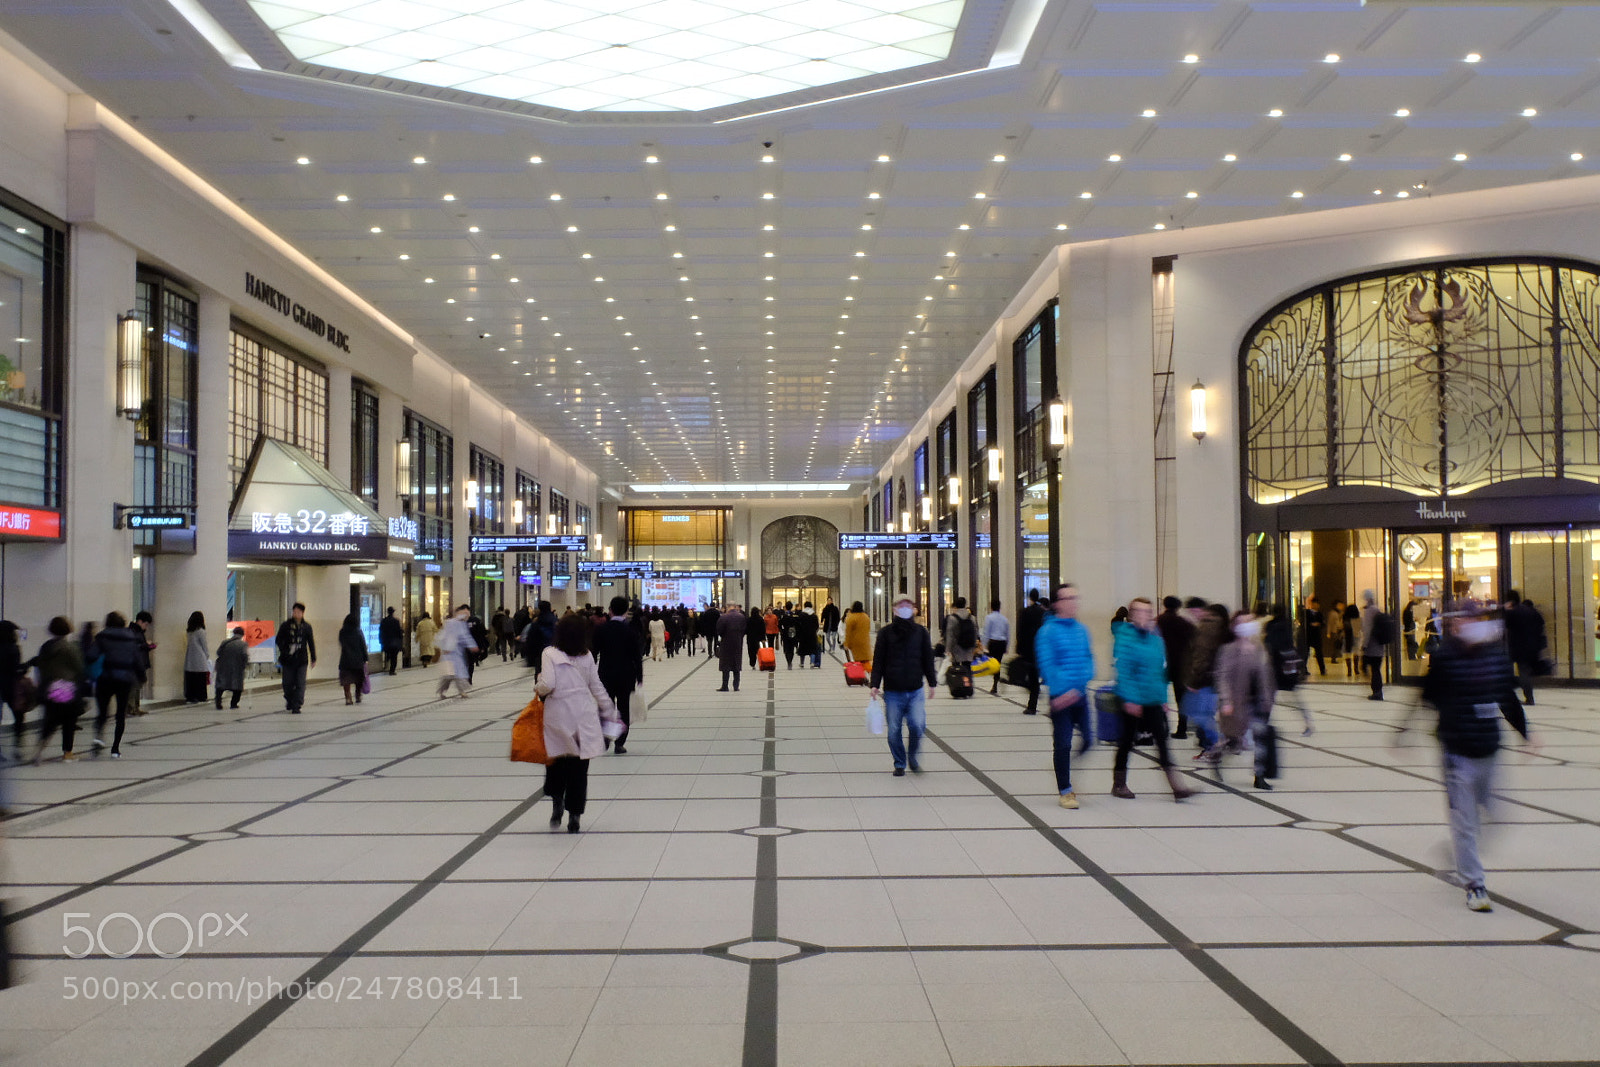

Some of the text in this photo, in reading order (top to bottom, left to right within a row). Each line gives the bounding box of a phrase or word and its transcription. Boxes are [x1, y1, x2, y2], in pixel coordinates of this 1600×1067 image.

[245, 271, 291, 317] HANKYU
[292, 303, 326, 338] GRAND
[251, 509, 369, 536] 阪急32番街
[1415, 500, 1467, 524] Hankyu
[259, 541, 360, 552] HANKYU GRAND BLDG.
